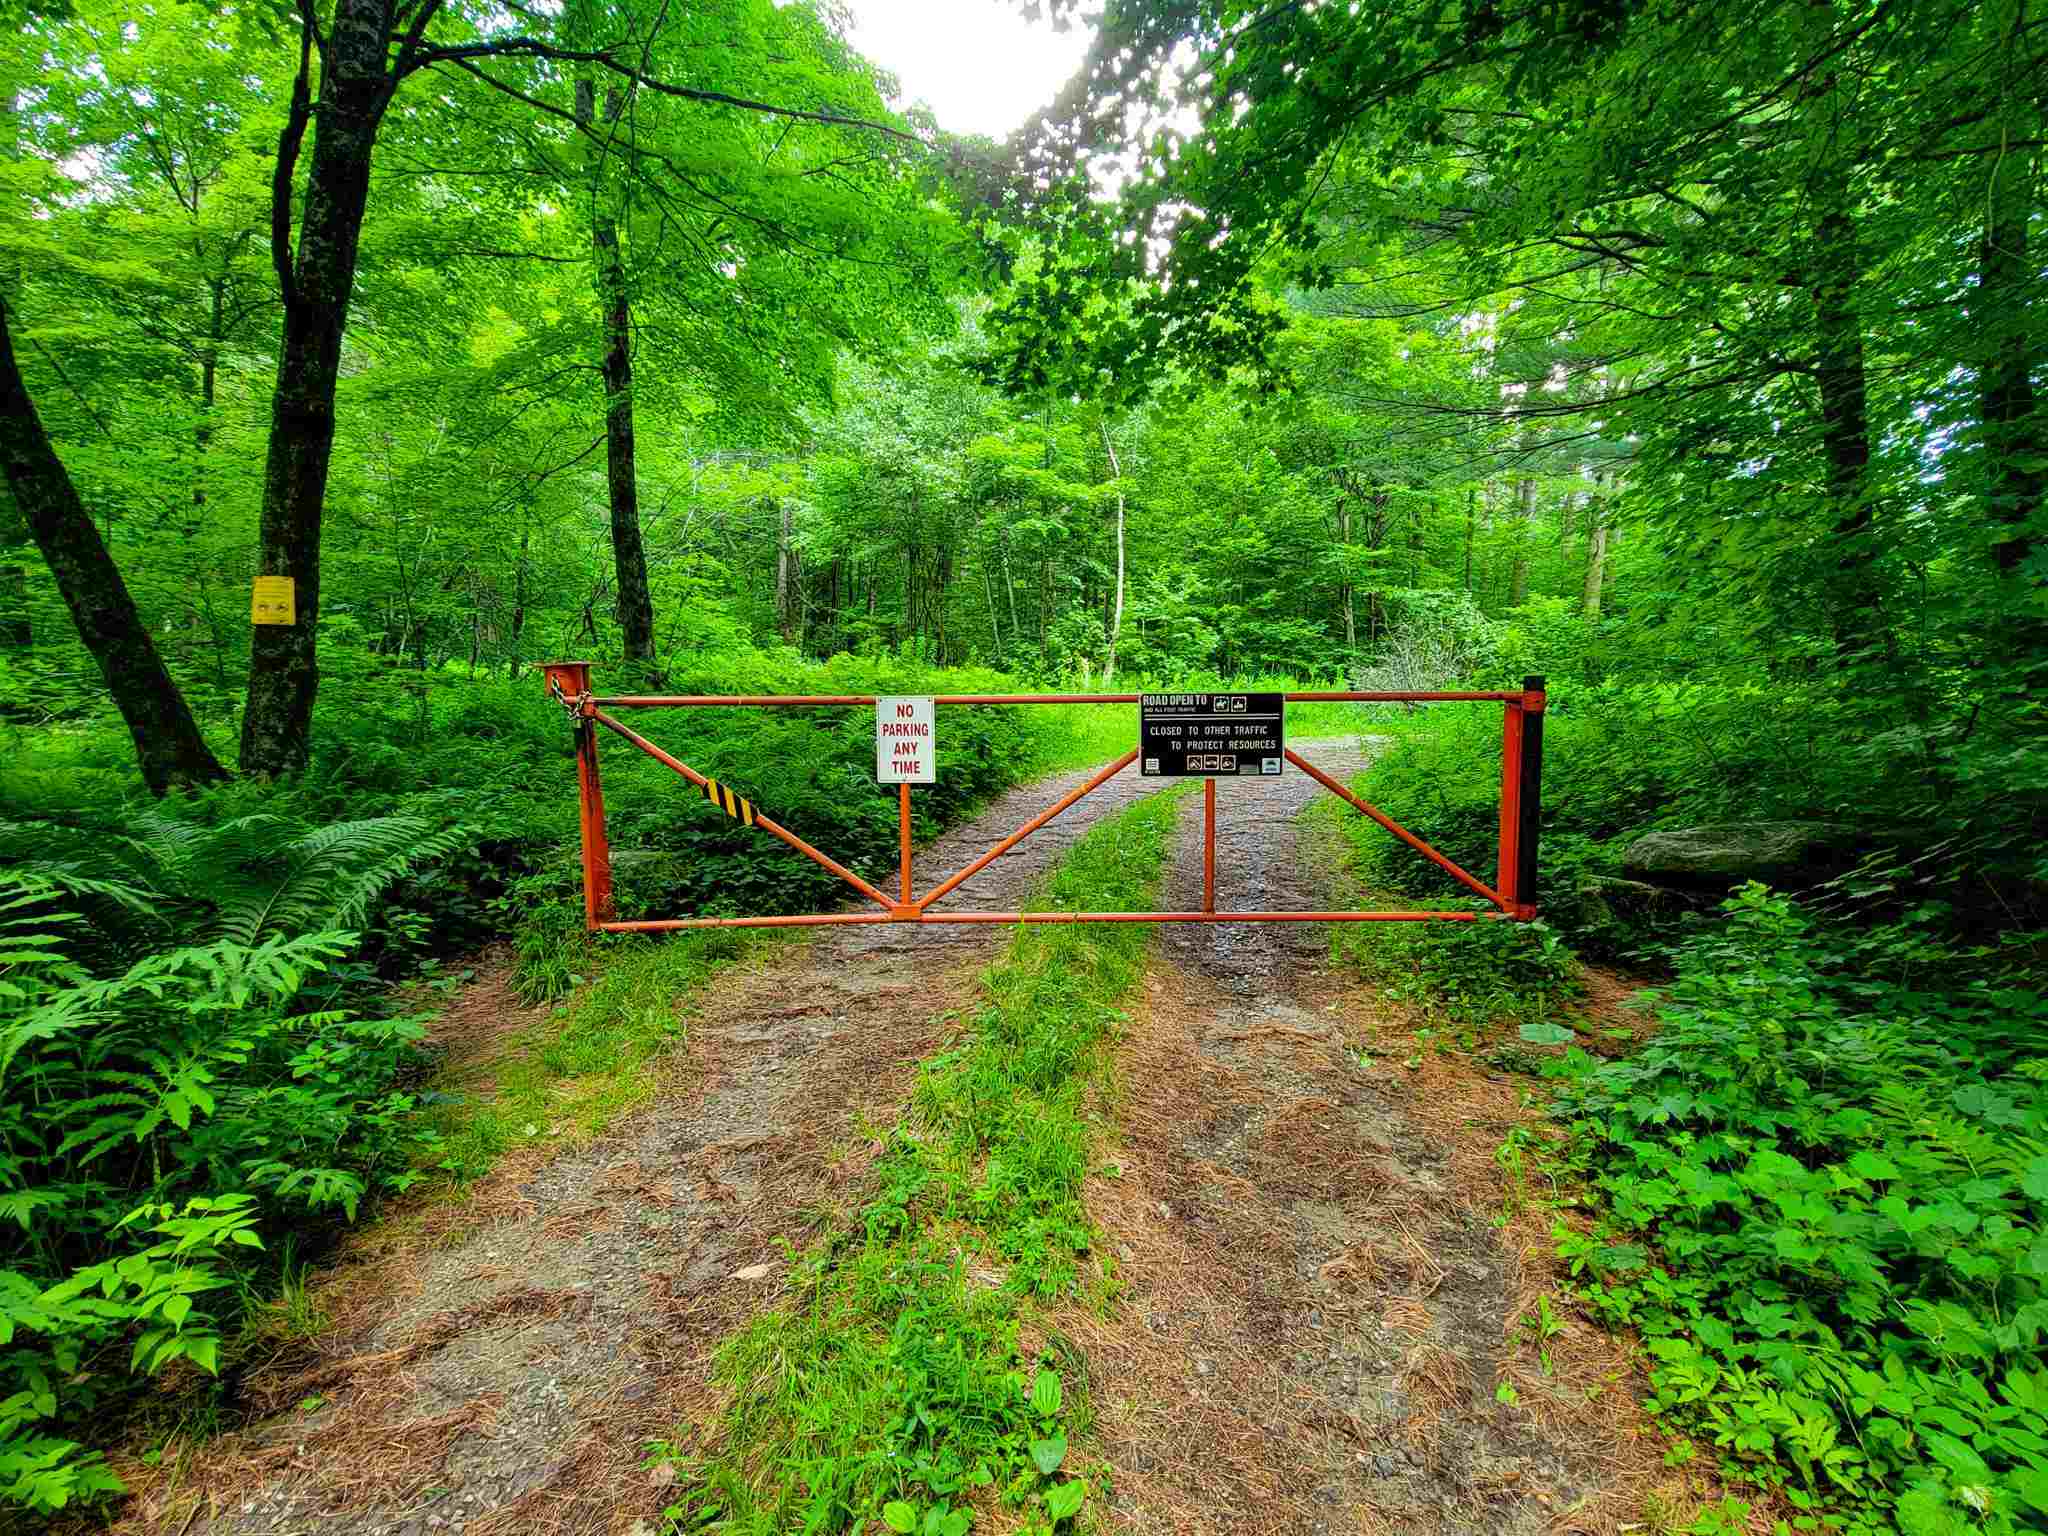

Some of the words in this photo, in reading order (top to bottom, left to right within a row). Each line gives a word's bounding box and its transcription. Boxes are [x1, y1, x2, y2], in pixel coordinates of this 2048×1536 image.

[1143, 695, 1167, 705] ROAD
[1169, 695, 1194, 705] OPEN
[1195, 695, 1207, 705] TO
[896, 704, 914, 718] NO
[882, 723, 929, 737] PARKING
[1150, 726, 1182, 736] CLOSED
[1189, 727, 1199, 736] TO
[1204, 726, 1231, 735] OTHER
[1235, 725, 1268, 735] TRAFFIC
[894, 741, 918, 755] ANY
[1171, 741, 1182, 751] TO
[1187, 740, 1224, 750] PROTECT
[1229, 740, 1276, 750] RESOURCES
[891, 760, 921, 774] TIME
